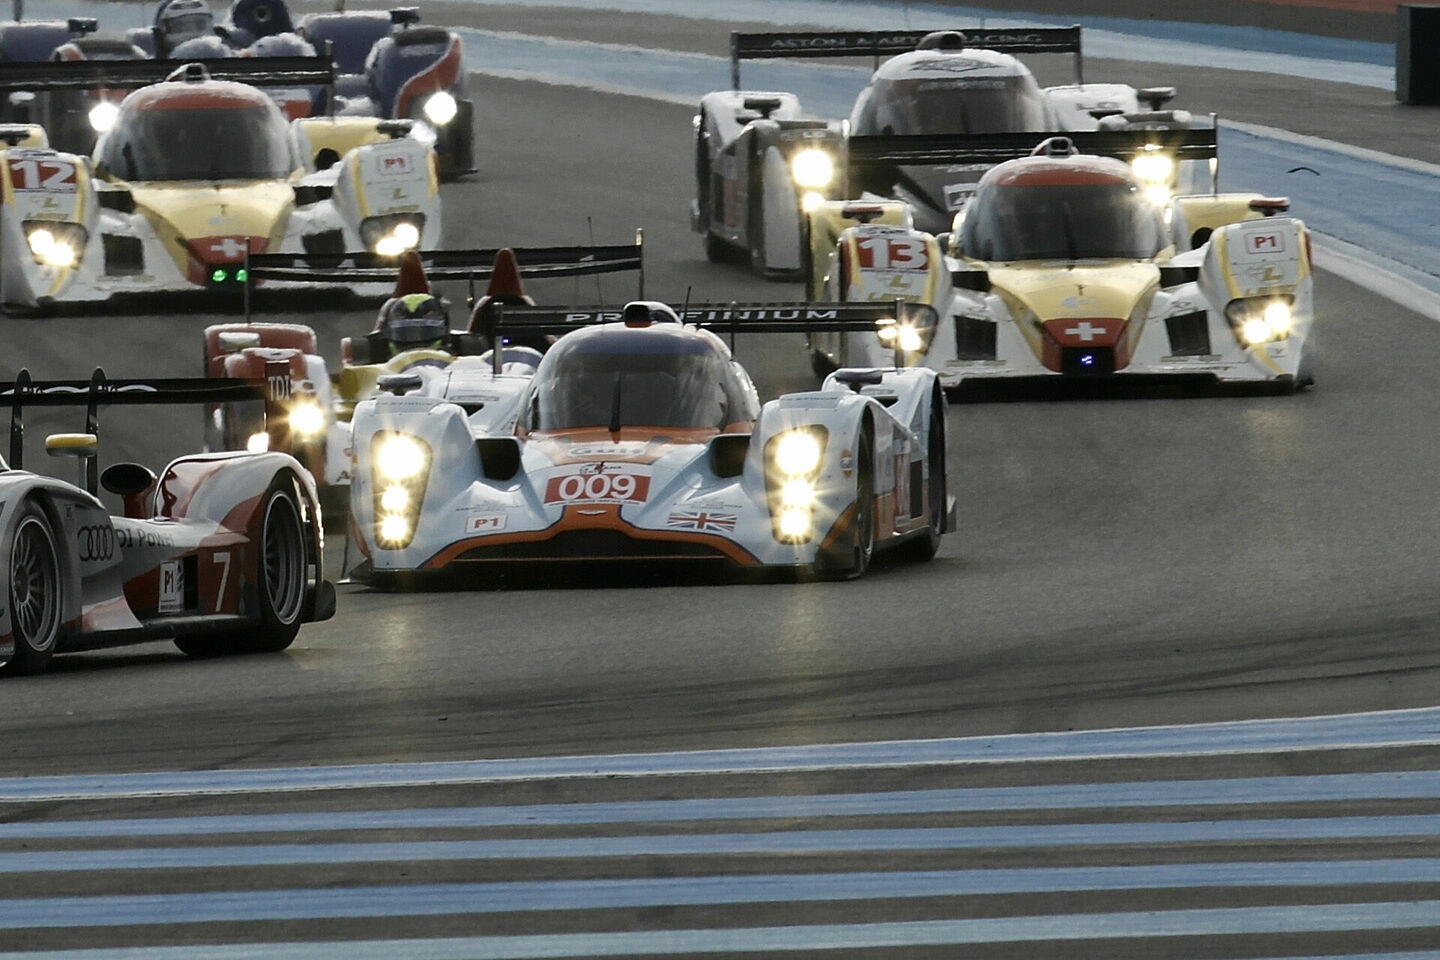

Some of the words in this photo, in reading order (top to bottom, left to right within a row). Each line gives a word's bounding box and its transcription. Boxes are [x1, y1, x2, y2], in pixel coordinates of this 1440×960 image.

[770, 37, 846, 48] ASTON
[11, 160, 77, 189] 12
[859, 238, 929, 269] 13
[1254, 235, 1277, 248] P1
[267, 375, 290, 401] TDI
[558, 474, 637, 501] 009
[474, 517, 499, 529] P1
[164, 570, 174, 594] P1
[213, 551, 231, 612] 7
